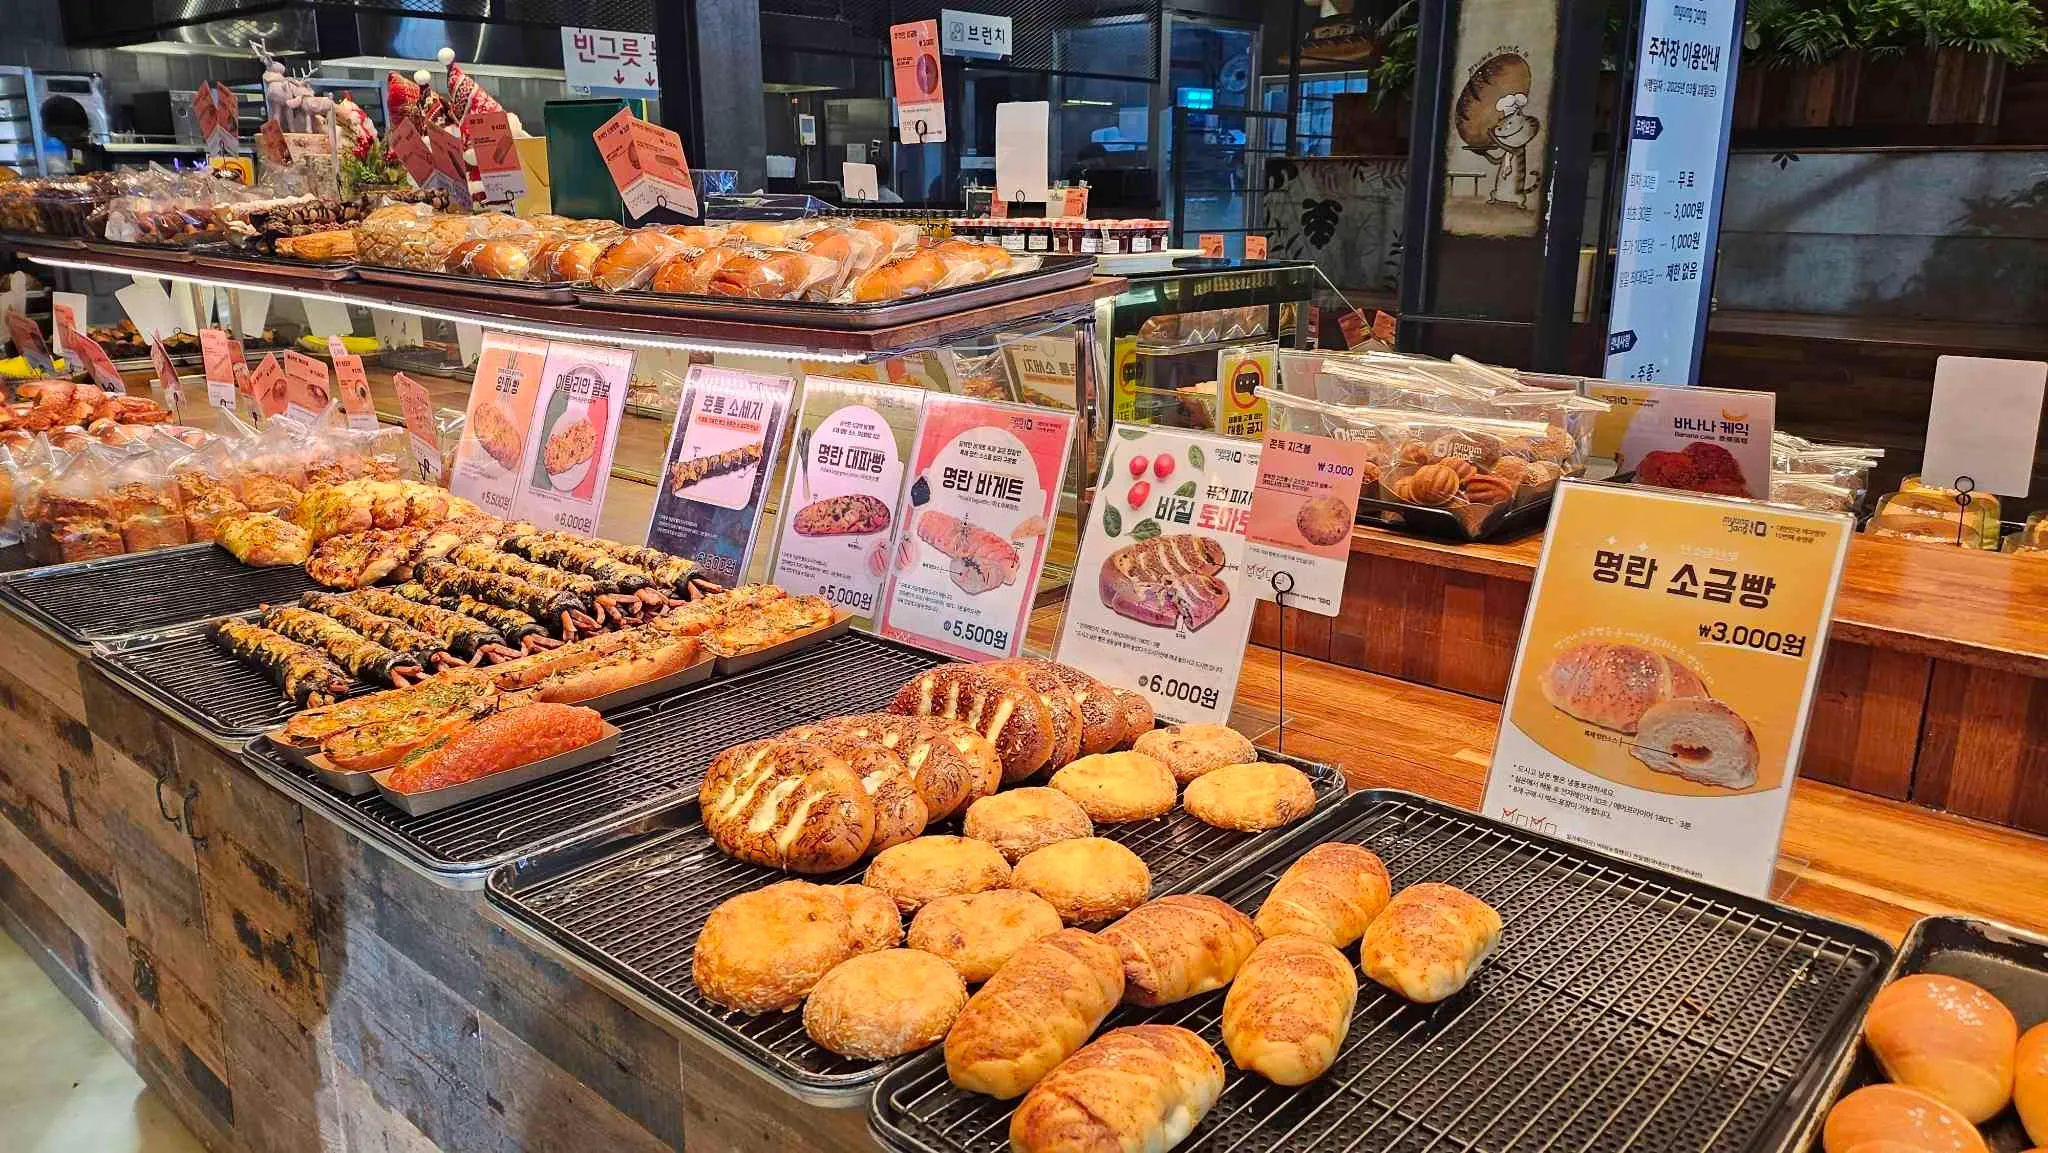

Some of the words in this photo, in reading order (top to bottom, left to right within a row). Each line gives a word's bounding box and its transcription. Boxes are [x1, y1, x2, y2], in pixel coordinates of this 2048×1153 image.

[968, 25, 1005, 46] 브런치
[574, 34, 642, 67] 빈그릇
[1648, 37, 1680, 67] 주차장
[1682, 42, 1720, 72] 이용안내
[1678, 171, 1695, 189] 무료
[1673, 201, 1705, 220] 3,000원
[1671, 231, 1701, 252] 1,000원
[1666, 263, 1681, 282] 제한
[1682, 261, 1698, 281] 없음
[1637, 363, 1655, 382] 주중
[555, 373, 591, 395] 이탈리안
[592, 379, 612, 398] 콤보
[727, 399, 764, 421] 소세지
[1247, 421, 1263, 434] 금지
[1674, 417, 1717, 433] 바나나
[1719, 420, 1749, 436] 케익
[818, 444, 843, 467] 명란
[845, 448, 886, 474] 대파빵
[942, 466, 975, 492] 명란
[976, 471, 1024, 503] 바게트
[1207, 485, 1229, 502] 퓨전
[1155, 495, 1196, 525] 바질
[1592, 549, 1658, 591] 명란
[1665, 562, 1776, 610] 소금빵
[1518, 765, 1537, 776] 드시고
[1538, 770, 1551, 780] 남은
[1552, 774, 1566, 784] 빵은
[1613, 802, 1654, 820] 에어프라이어
